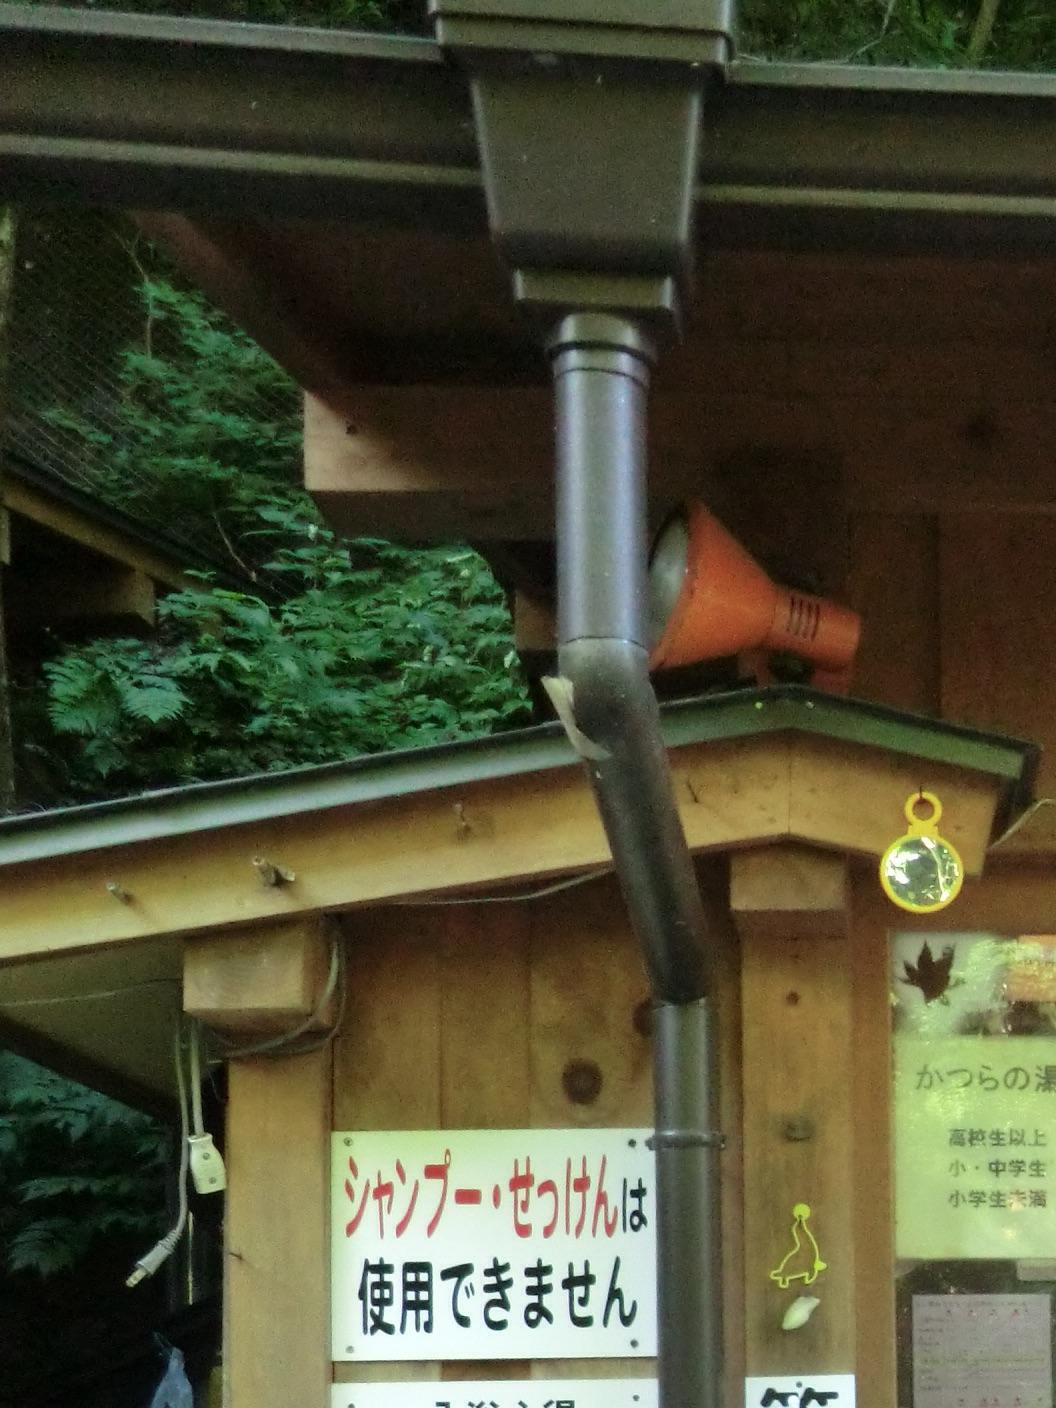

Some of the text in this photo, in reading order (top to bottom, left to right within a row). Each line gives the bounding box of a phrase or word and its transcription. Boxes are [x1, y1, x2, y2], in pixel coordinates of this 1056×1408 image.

[949, 1128, 1047, 1148] 高校生以上
[949, 1159, 1047, 1178] 小・中学生
[344, 1148, 648, 1239] シャンプー・せっけんは
[949, 1190, 1047, 1209] 小学生未満
[358, 1256, 638, 1336] 使用できません
